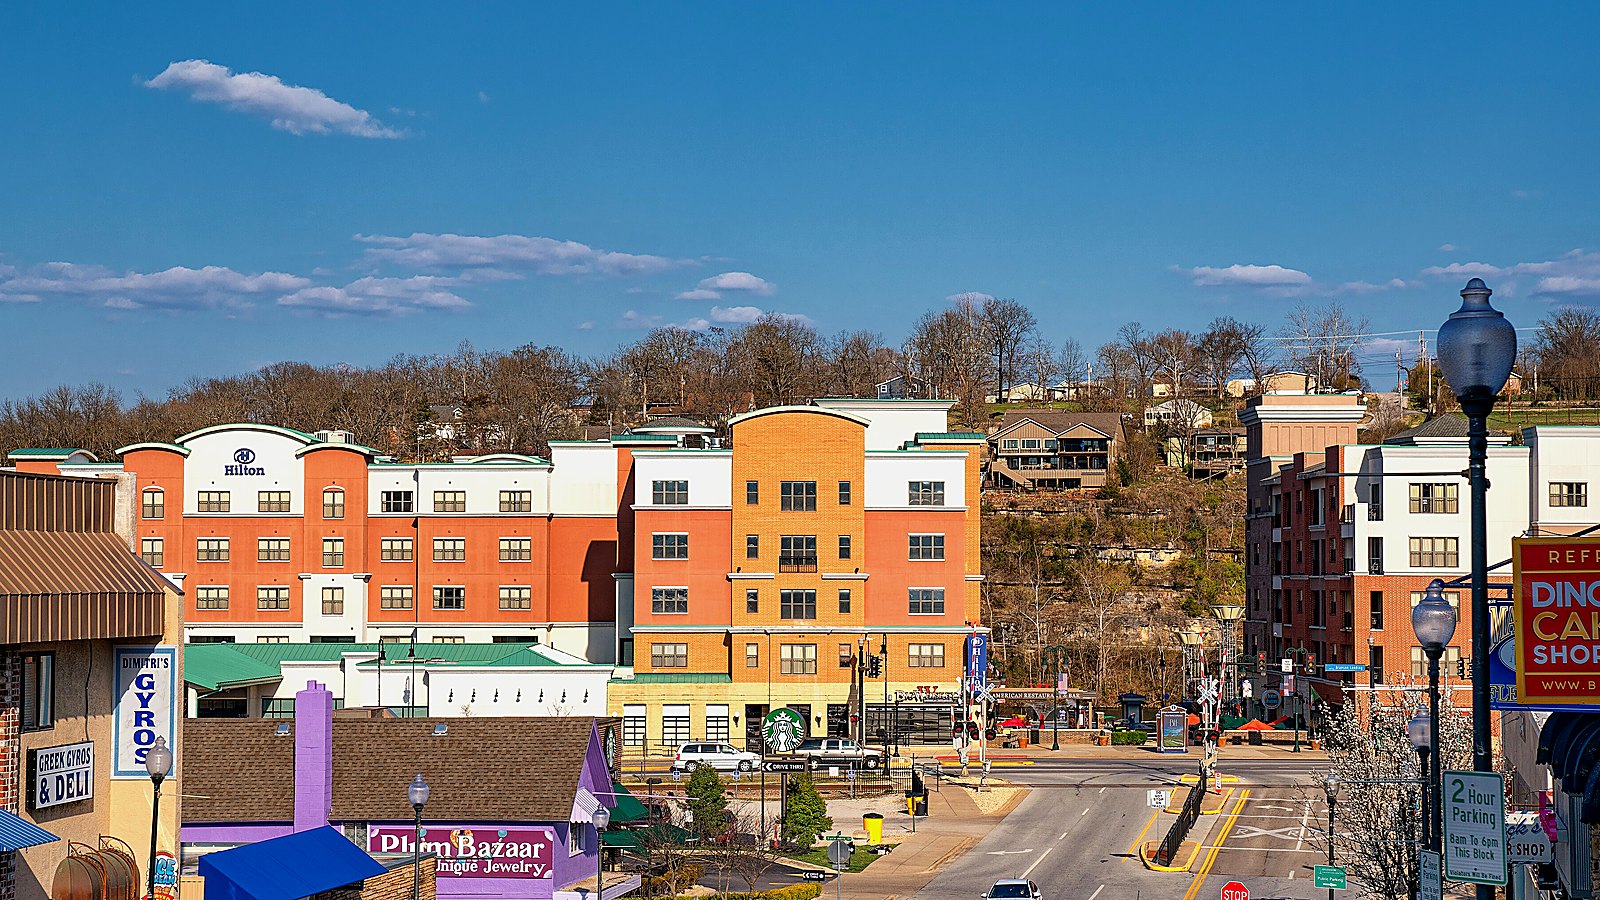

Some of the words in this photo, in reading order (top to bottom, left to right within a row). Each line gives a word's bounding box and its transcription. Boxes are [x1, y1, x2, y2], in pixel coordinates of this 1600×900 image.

[224, 464, 265, 476] Hilton
[122, 658, 169, 669] DIMITRI'S
[133, 673, 156, 765] GYROS
[39, 751, 65, 772] GREEK
[66, 747, 91, 767] GYROS
[39, 777, 50, 804] &
[55, 770, 89, 801] DELI
[1451, 779, 1464, 803] 2
[1468, 789, 1495, 806] Hour
[1452, 806, 1496, 829] Parking
[457, 835, 546, 859] Bazaar
[1449, 834, 1467, 845] 8am
[1469, 835, 1479, 846] To
[1481, 837, 1499, 849] 6pm
[1516, 843, 1545, 856] SHOP
[1422, 854, 1428, 868] 2
[1454, 846, 1470, 858] This
[1473, 848, 1495, 860] Block
[483, 859, 547, 877] Jewelry
[1223, 889, 1248, 900] STOP
